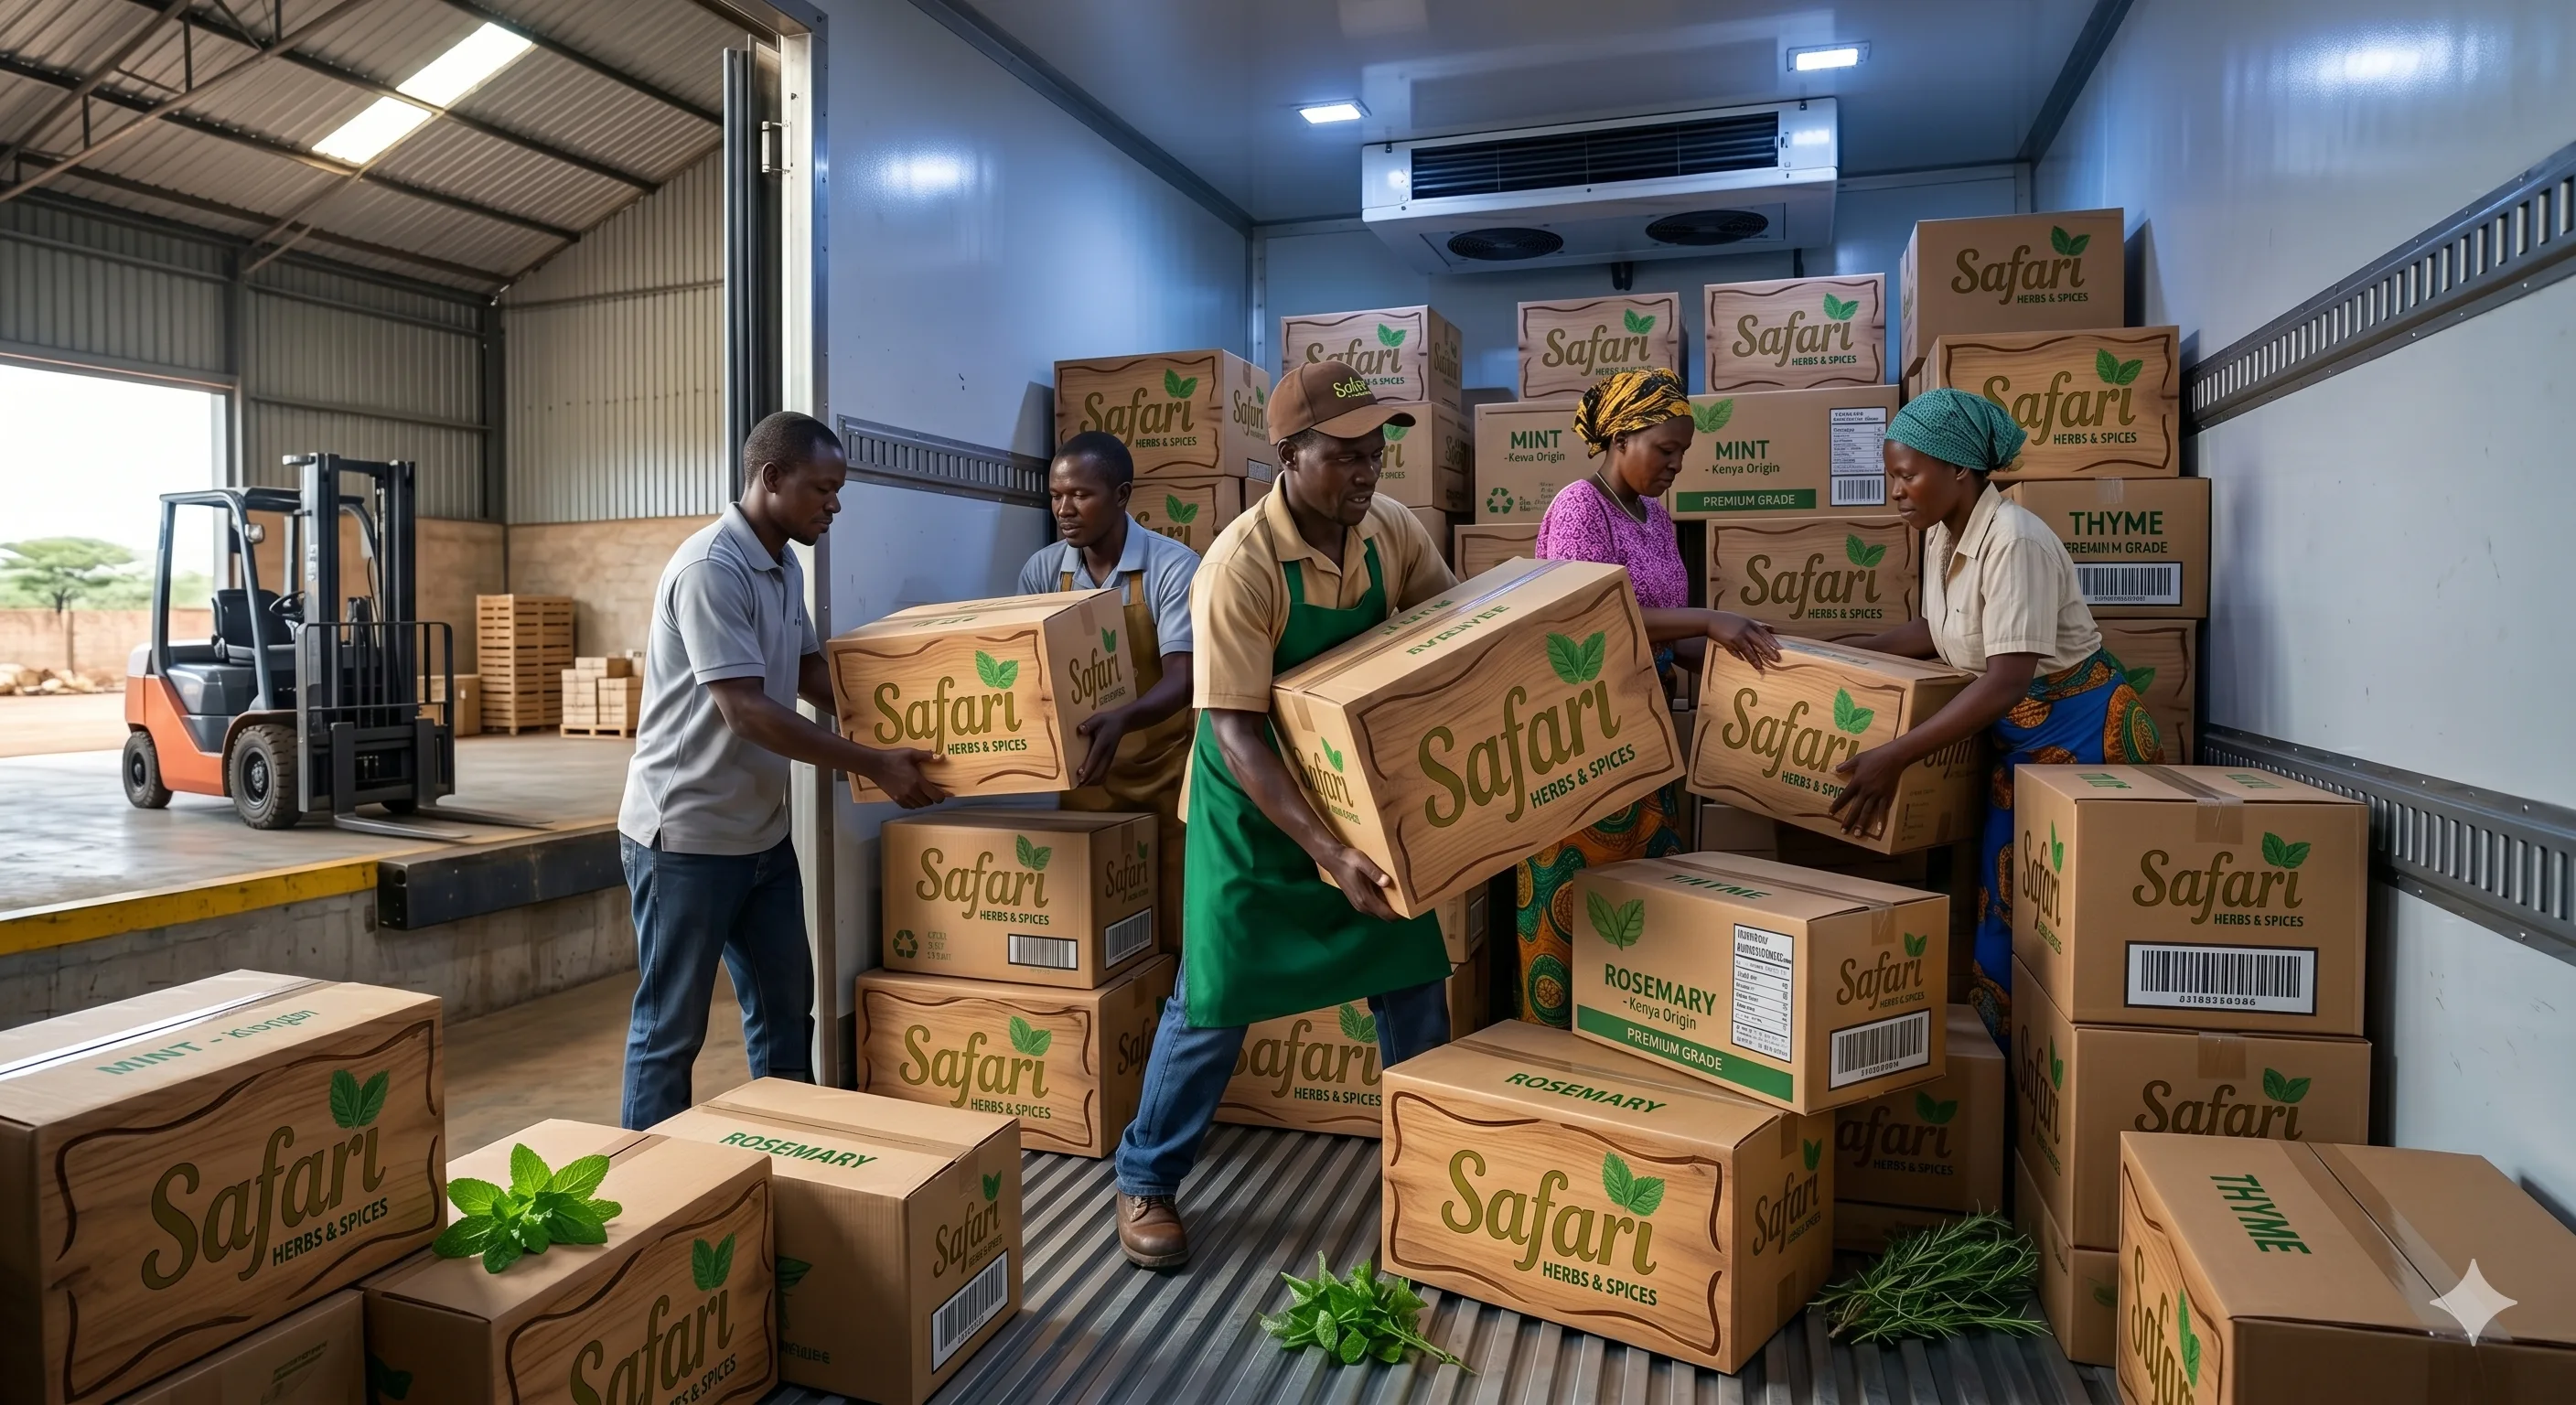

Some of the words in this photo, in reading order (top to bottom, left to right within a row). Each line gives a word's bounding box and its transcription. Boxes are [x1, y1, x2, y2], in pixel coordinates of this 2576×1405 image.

[1951, 244, 2086, 306] Safari
[2017, 294, 2045, 304] HERBS
[2049, 293, 2055, 303] &
[2057, 293, 2088, 303] SPICES
[1542, 324, 1650, 377] Safari
[1732, 310, 1854, 368] Safari
[1791, 357, 1819, 366] HERBS
[1820, 356, 1827, 364] &
[1828, 355, 1857, 364] SPICES
[1079, 387, 1195, 448] Safari
[1982, 370, 2137, 446] Safari
[1136, 438, 1161, 448] HERBS
[1162, 437, 1168, 446] &
[1170, 436, 1197, 446] SPICES
[1510, 430, 1562, 450] MINT
[1537, 451, 1565, 464] Origin
[1716, 439, 1770, 461] MINT
[2053, 434, 2088, 445] HERBS
[2089, 433, 2098, 444] &
[2100, 432, 2137, 444] SPICES
[1712, 464, 1744, 476] Kenya
[1746, 463, 1780, 476] Origin
[1703, 496, 1755, 507] PREMIUM
[1758, 494, 1796, 505] GRADE
[2069, 510, 2163, 536] THYME
[2125, 542, 2168, 554] GRADE
[1740, 552, 1882, 620] Safari
[1808, 609, 1838, 618] HERBS
[1840, 609, 1847, 618] &
[1850, 609, 1883, 618] SPICES
[874, 675, 1023, 756] Safari
[1723, 688, 1860, 778] Safari
[948, 742, 981, 756] HERBS
[982, 741, 990, 752] &
[992, 739, 1027, 752] SPICES
[1418, 681, 1622, 828] Safari
[1293, 746, 1354, 810] Safari
[1530, 774, 1575, 809] HERBS
[1577, 768, 1588, 786] &
[1588, 743, 1636, 779] SPICES
[1813, 780, 1820, 792] &
[1822, 783, 1844, 799] SPIC
[916, 847, 1049, 920] Safari
[1105, 853, 1149, 904] Safari
[2023, 830, 2061, 930] Safari
[2132, 849, 2303, 925] Safari
[980, 910, 1008, 922] HERBS
[1010, 913, 1017, 923] &
[1019, 913, 1050, 926] SPICES
[2214, 913, 2251, 926] HERBS
[2254, 915, 2261, 926] &
[2264, 916, 2304, 928] SPICES
[1605, 962, 1717, 1016] ROSEMARY
[1837, 951, 1924, 1012] Safari
[1630, 997, 1660, 1020] Kenya
[1663, 1008, 1697, 1031] Origin
[95, 1041, 203, 1076] MINT
[899, 1024, 1049, 1109] Safari
[1627, 1027, 1680, 1056] PREMIUM
[1682, 1046, 1723, 1071] GRADE
[971, 1098, 1004, 1114] HERBS
[1005, 1103, 1014, 1114] &
[1014, 1103, 1052, 1120] SPICES
[1293, 1087, 1330, 1101] HERBS
[1332, 1090, 1341, 1103] &
[1343, 1091, 1382, 1107] SPICES
[1504, 1072, 1667, 1113] ROSEMARY
[2020, 1024, 2060, 1145] Safari
[2134, 1079, 2303, 1141] Safari
[719, 1132, 878, 1169] ROSEMARY
[1834, 1105, 1953, 1168] afari
[1873, 1159, 1906, 1172] HERBS
[1908, 1162, 1916, 1173] &
[1917, 1162, 1954, 1176] SPICES
[141, 1125, 387, 1291] Safari
[274, 1228, 323, 1267] HERBS
[326, 1222, 338, 1242] &
[340, 1197, 388, 1238] SPICES
[1442, 1149, 1658, 1276] Safari
[1753, 1171, 1820, 1257] Safari
[2209, 1174, 2313, 1255] THYME
[933, 1200, 1001, 1279] Safari
[1542, 1260, 1589, 1288] HERBS
[1592, 1273, 1603, 1292] &
[1606, 1277, 1658, 1306] SPICES
[570, 1289, 735, 1405] Safari
[701, 1354, 735, 1394] SPICES
